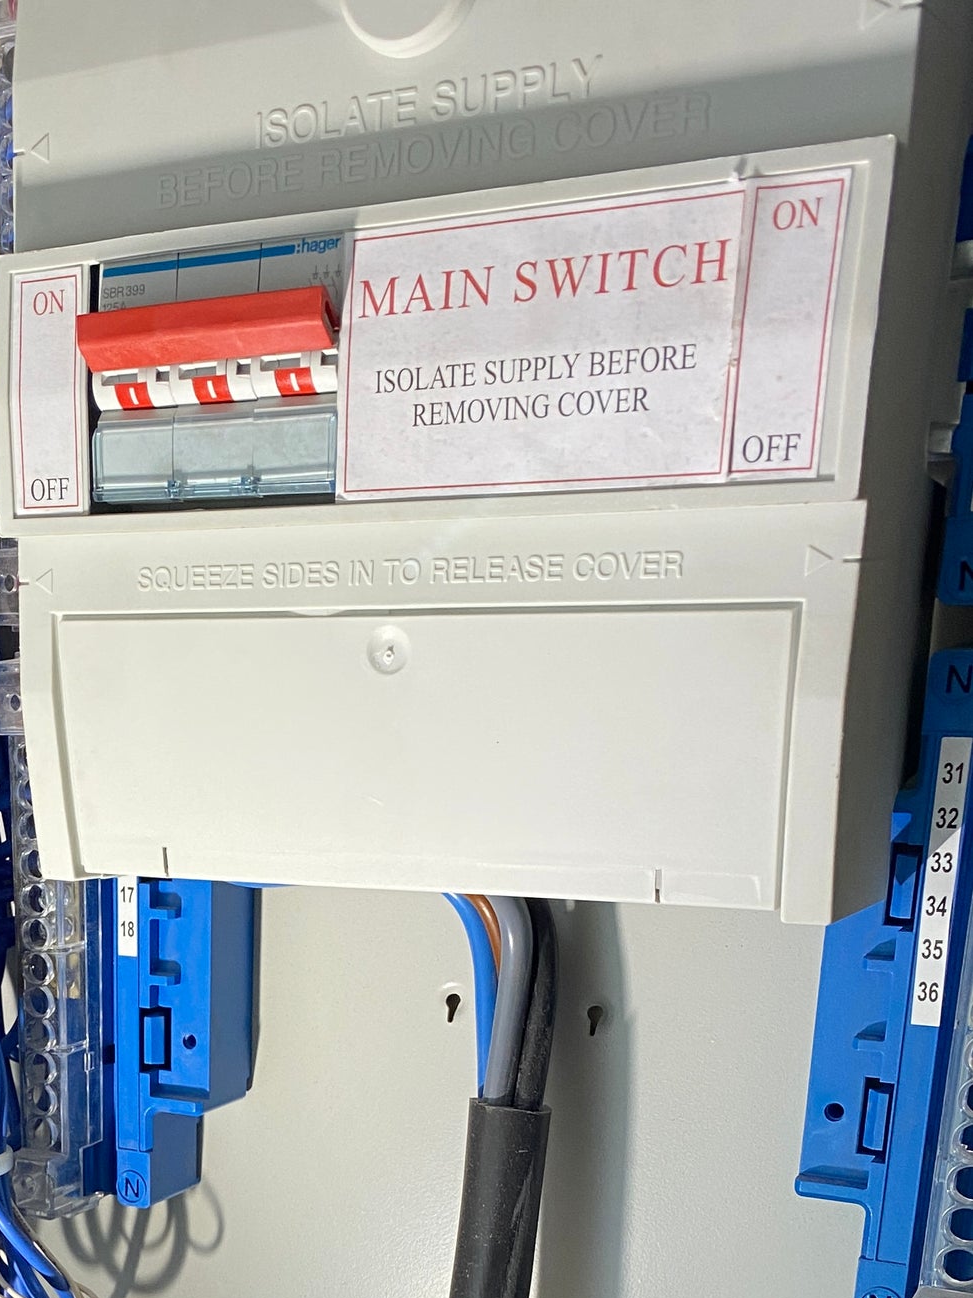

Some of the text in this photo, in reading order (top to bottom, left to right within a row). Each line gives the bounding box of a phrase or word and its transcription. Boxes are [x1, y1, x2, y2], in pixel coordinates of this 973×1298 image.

[256, 55, 604, 150] ISOLATE SUPPLY
[159, 91, 713, 211] BEFORE REMOVING COVER
[773, 197, 823, 230] ON
[359, 239, 732, 319] MAIN SWITCH
[33, 289, 65, 317] ON
[375, 343, 698, 394] ISOLATE SUPPLY BEFORE
[413, 387, 650, 428] REMOVING COVER
[742, 433, 802, 464] OFF
[30, 477, 70, 503] OFF
[137, 551, 684, 592] SQUEEZE SIDES IN TO RELEASE COVER
[945, 664, 973, 694] N
[942, 763, 965, 784] 31
[936, 808, 959, 828] 32
[930, 852, 953, 873] 33
[120, 886, 135, 902] 17
[925, 896, 948, 917] 34
[120, 920, 135, 938] 18
[921, 939, 944, 961] 35
[917, 981, 940, 1003] 36
